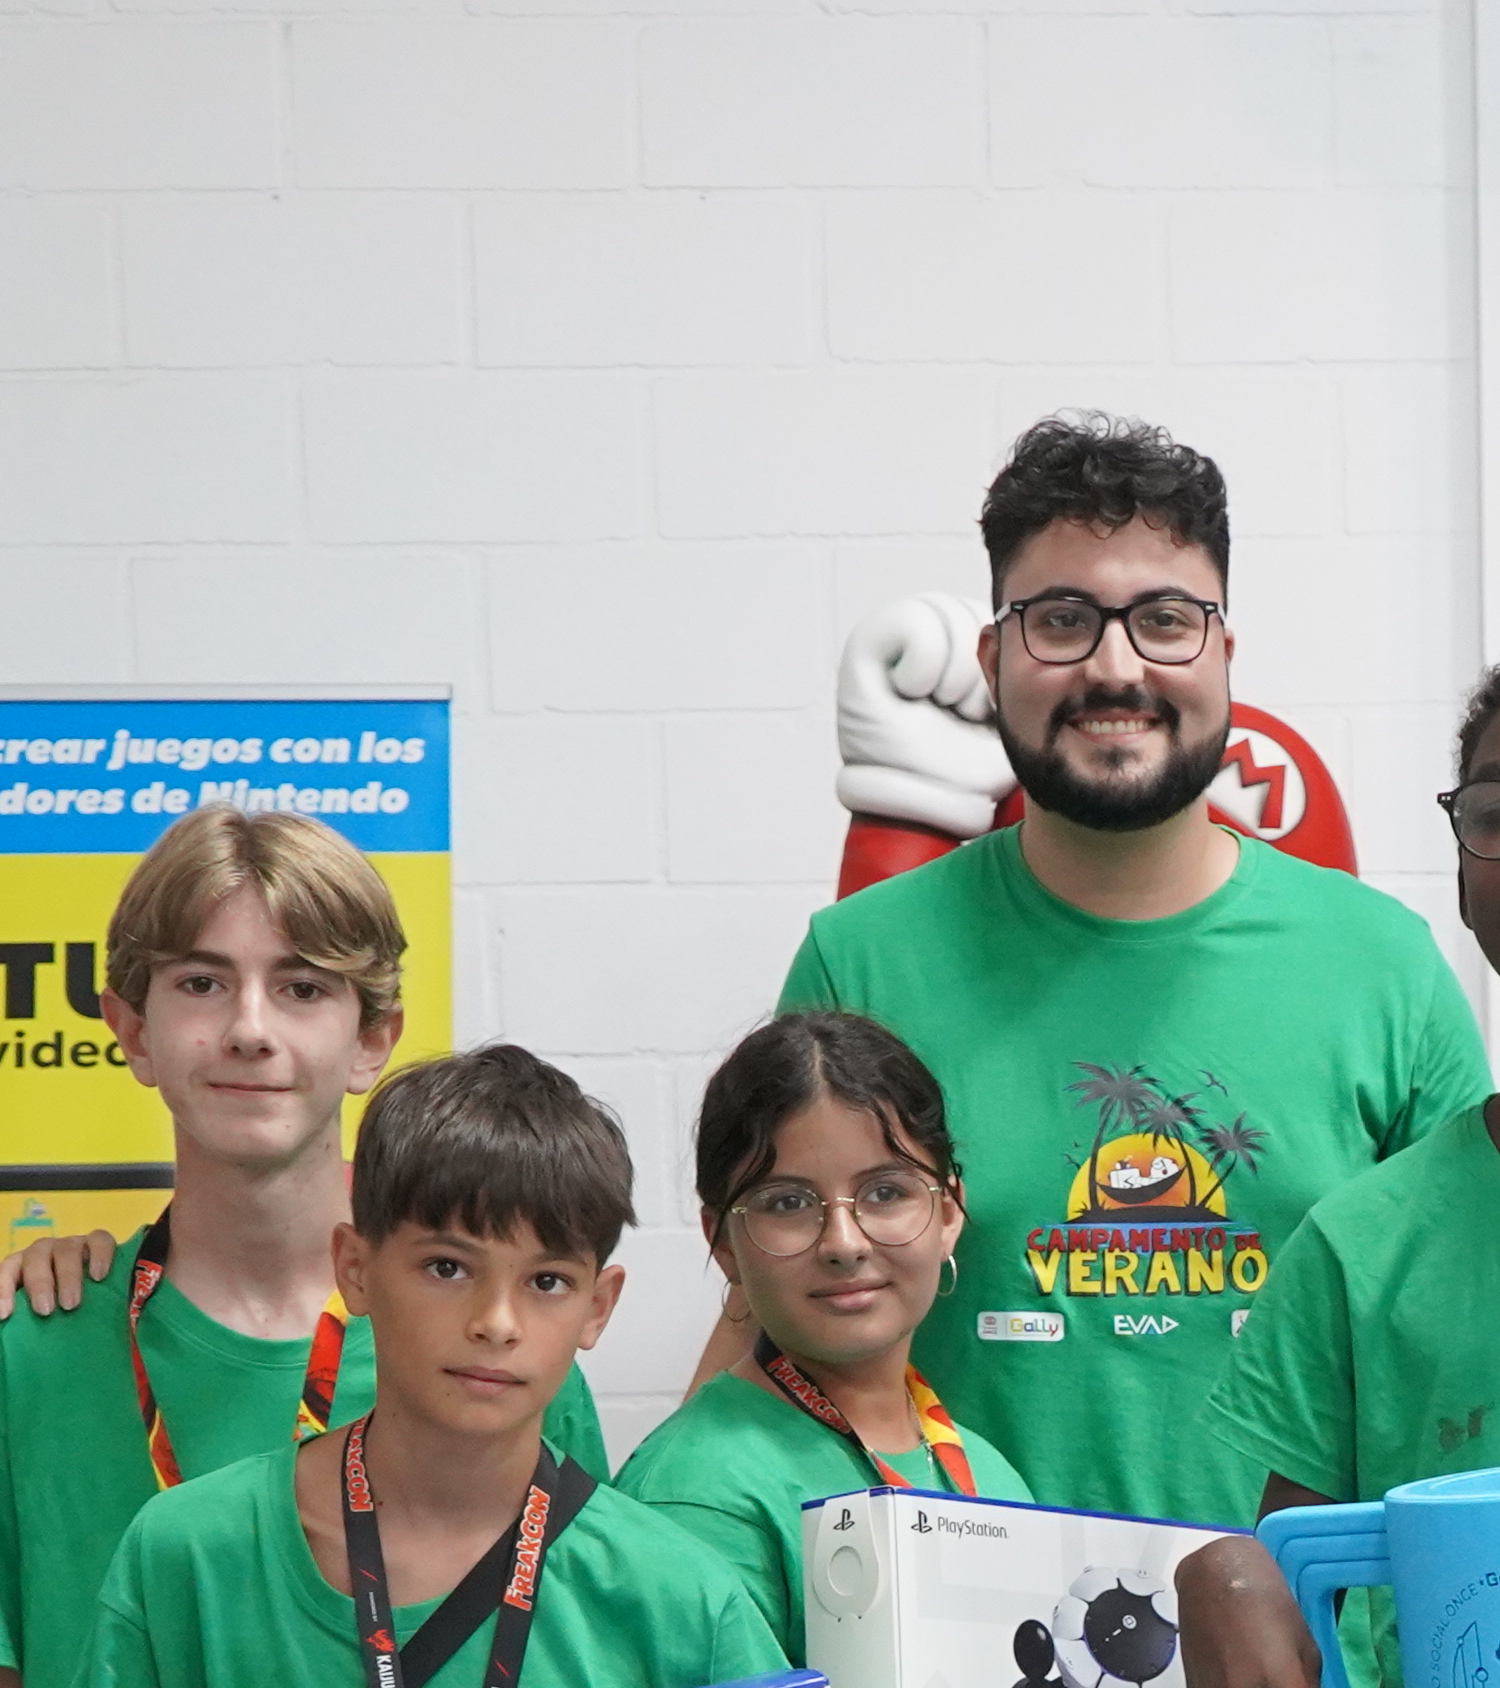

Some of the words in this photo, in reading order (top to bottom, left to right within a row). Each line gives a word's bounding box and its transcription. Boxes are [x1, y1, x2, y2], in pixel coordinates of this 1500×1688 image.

[105, 728, 264, 771] juegos
[269, 737, 351, 764] con
[357, 730, 426, 764] los
[130, 781, 192, 814] de
[196, 778, 410, 814] Nintendo
[1027, 1227, 1227, 1253] CAMPAMENTO
[1233, 1233, 1263, 1250] DE
[1026, 1245, 1269, 1296] VERANO
[1010, 1317, 1059, 1337] Gally
[766, 1355, 850, 1435] FREAKCON
[937, 1516, 1010, 1539] PlayStation
[502, 1485, 551, 1611] FREAKCON
[1445, 1582, 1479, 1618] ONCE
